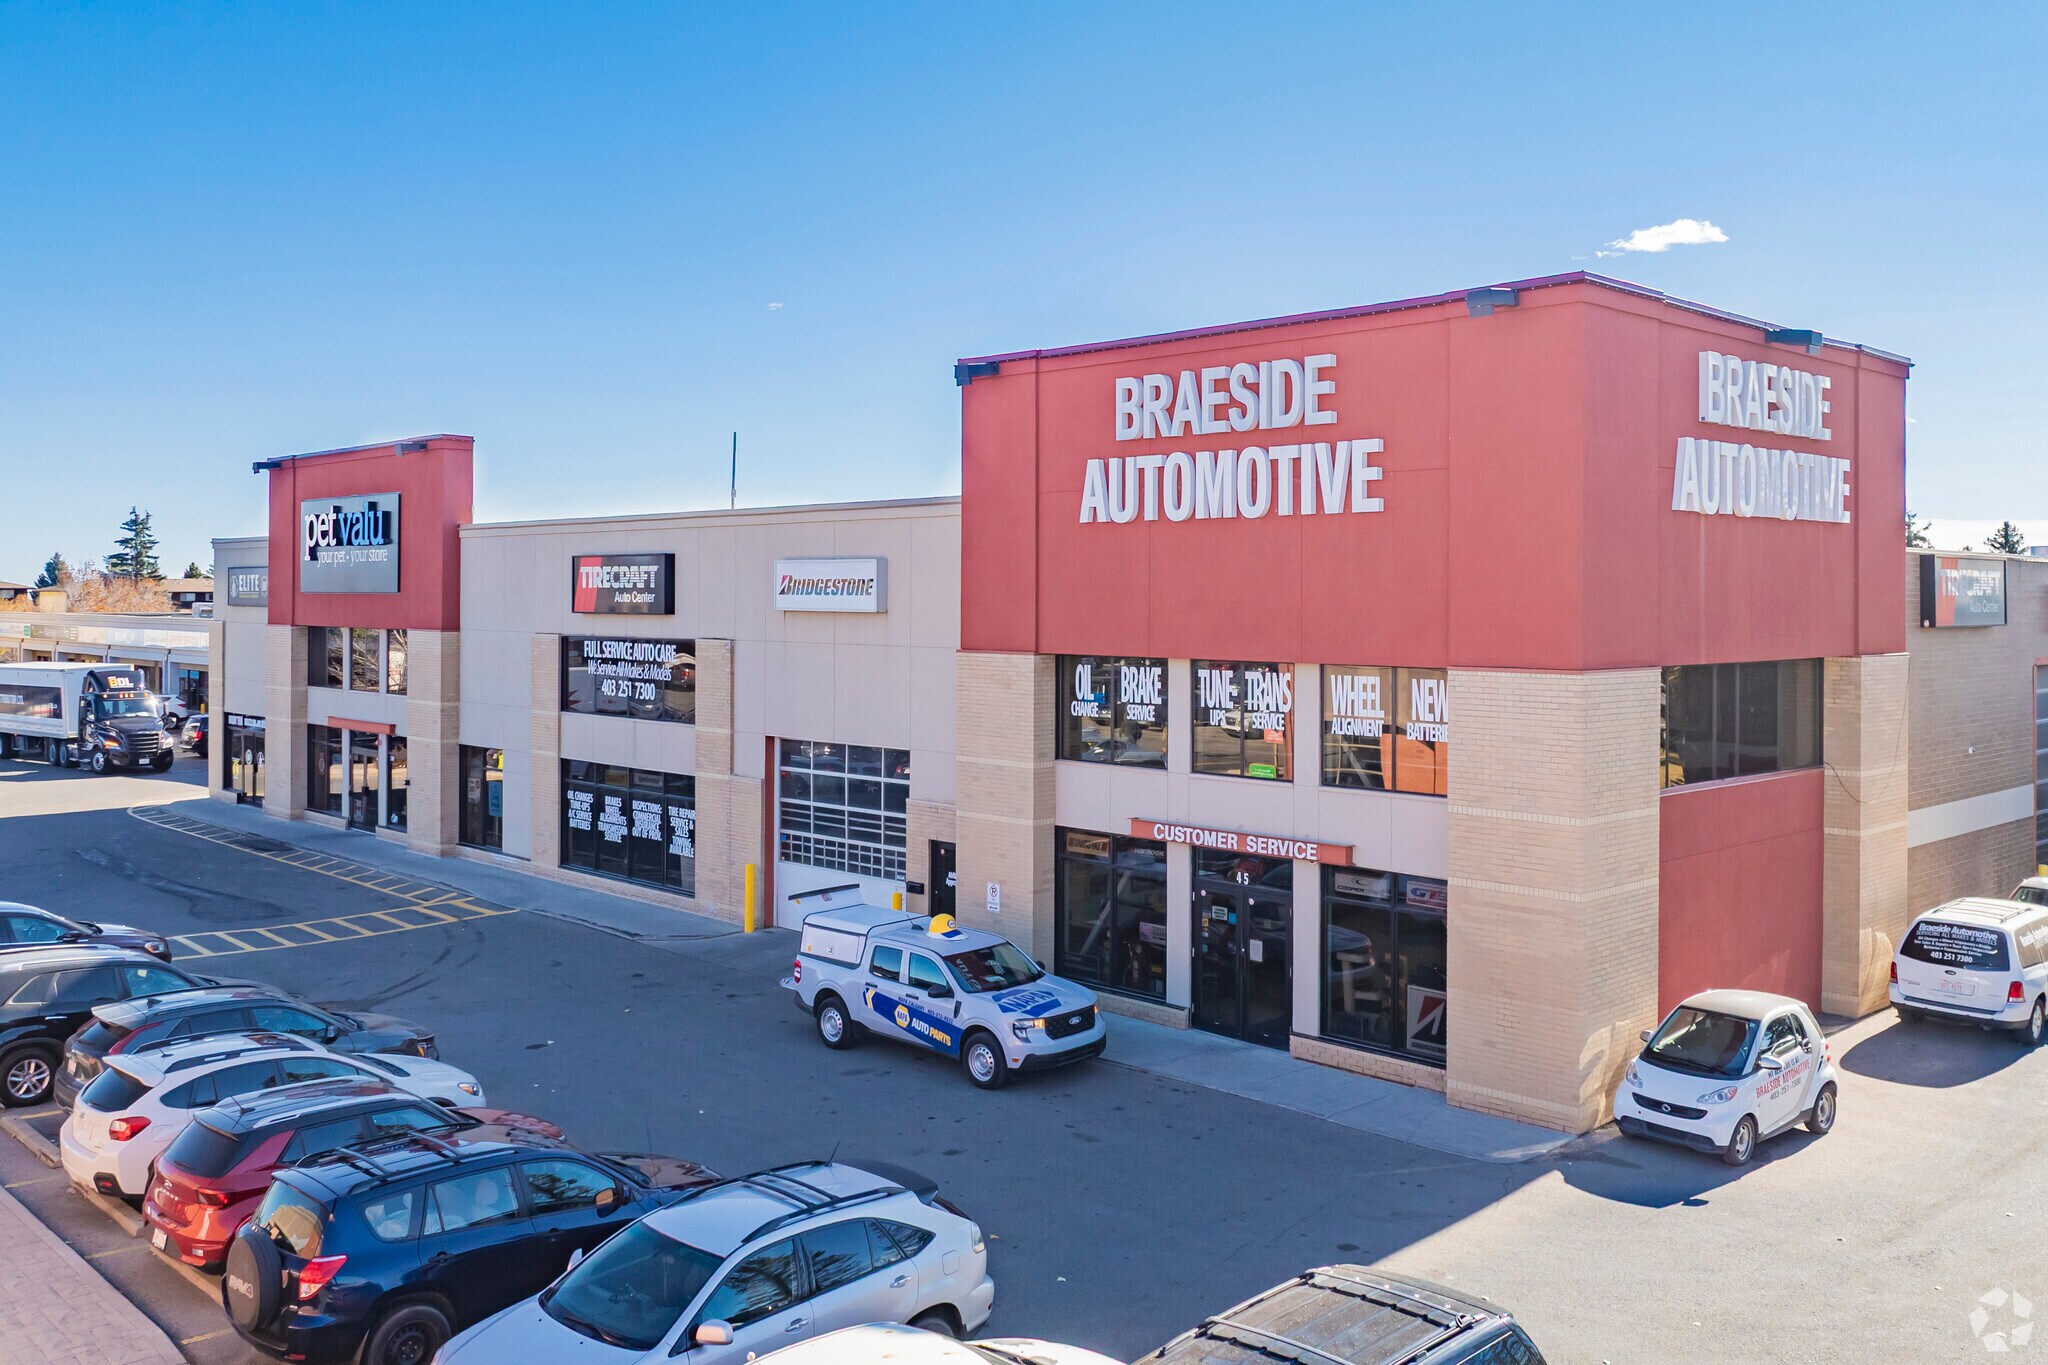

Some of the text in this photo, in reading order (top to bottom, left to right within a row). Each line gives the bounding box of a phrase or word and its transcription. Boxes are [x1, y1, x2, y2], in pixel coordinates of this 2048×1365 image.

[1116, 353, 1337, 441] BRAESIDE
[1699, 351, 1831, 441] BRAESIDE
[1079, 438, 1384, 523] AUTOMOTIVE
[1672, 437, 1850, 524] AUTOMOTIVE
[304, 501, 384, 561] pet valu
[317, 549, 388, 567] your pet your store
[238, 574, 260, 592] ELITE
[580, 565, 659, 588] TIRECRAFT
[778, 575, 874, 596] BRIDGESTONE
[614, 591, 656, 603] Auto Center
[1969, 600, 2000, 613] Auto Center
[583, 640, 677, 662] FULL SERVICE AUTO CARE
[587, 659, 672, 681] We Service All Makes & Models
[601, 679, 656, 700] 403 251 7300
[1075, 664, 1095, 700] OIL
[1120, 666, 1162, 705] BRAKE
[1244, 671, 1292, 713] TRANS
[1330, 674, 1385, 718] WHEEL
[1411, 678, 1448, 723] NEW
[1070, 701, 1099, 718] CHANGE
[1126, 704, 1156, 722] SERVICE
[1209, 709, 1226, 726] UPS
[1252, 712, 1285, 731] SERVICE
[1331, 717, 1384, 738] ALIGNMENT
[1153, 823, 1318, 861] CUSTOMER SERVICE
[1236, 871, 1249, 885] 45
[1919, 923, 1998, 940] Braeside Automotive
[1944, 952, 1955, 960] 251
[1957, 954, 1973, 963] 7300
[1002, 989, 1051, 1010] NAPA
[896, 1009, 951, 1046] NAPA AUTO PARTS
[1756, 1059, 1810, 1098] BRAESIDE AUTOMOTIVE
